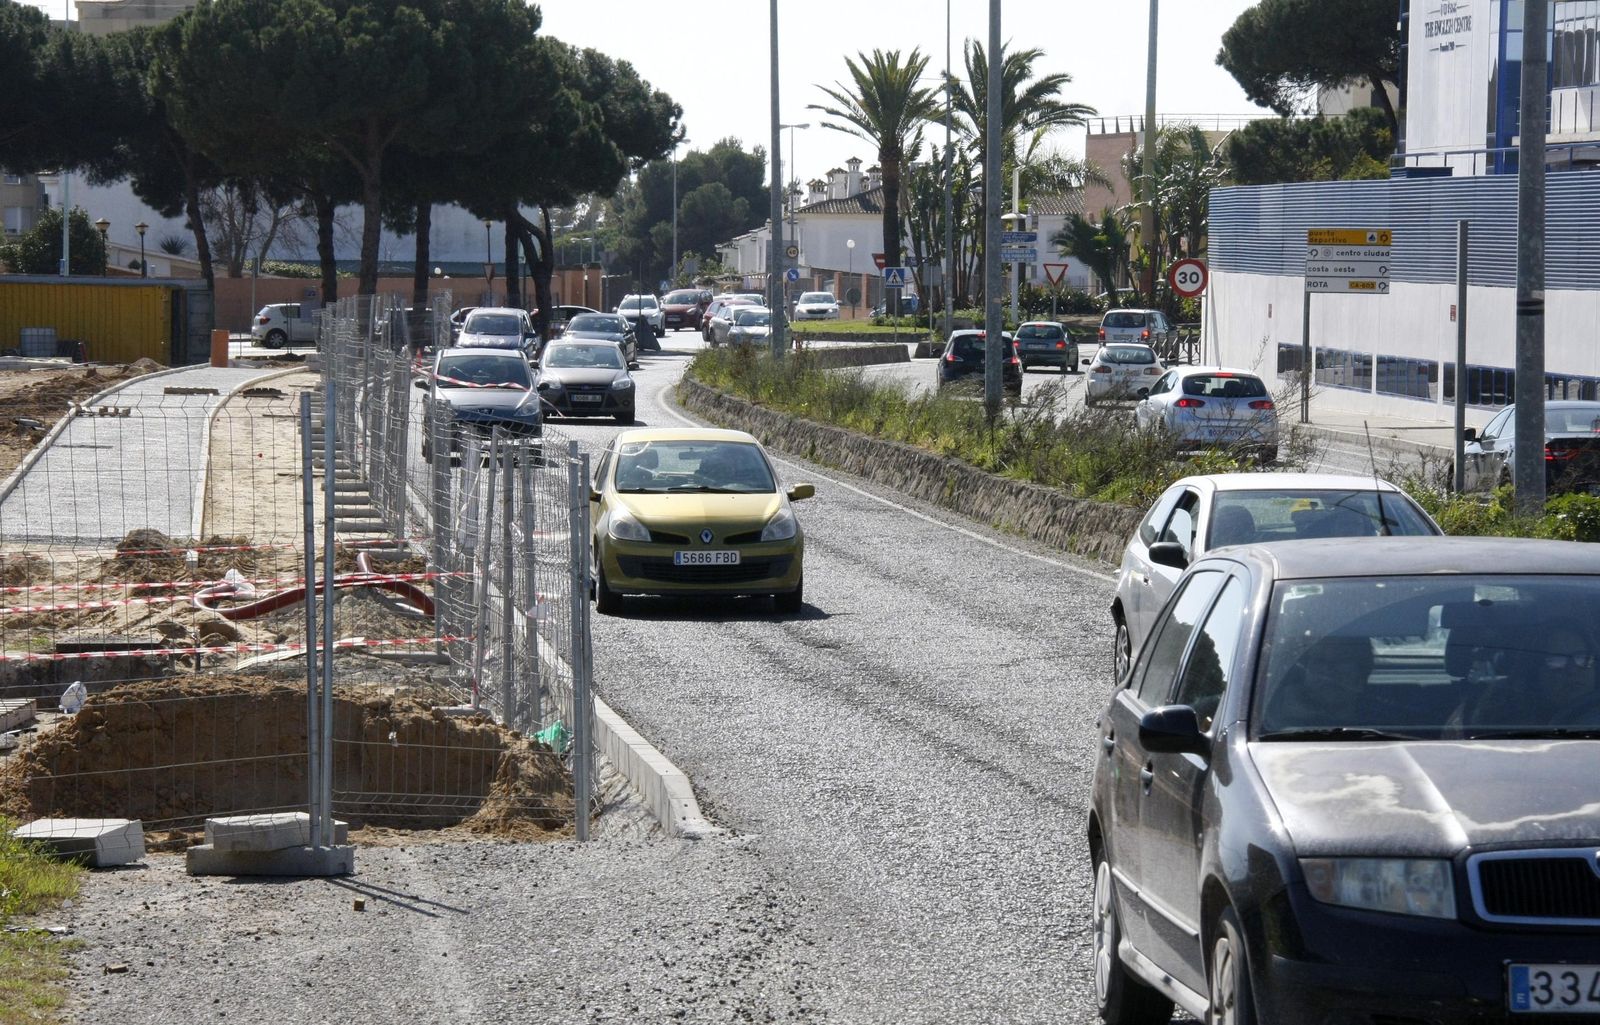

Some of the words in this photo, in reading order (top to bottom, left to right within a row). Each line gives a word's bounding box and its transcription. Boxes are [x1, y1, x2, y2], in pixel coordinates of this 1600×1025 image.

[1425, 21, 1434, 38] THE
[1454, 15, 1472, 34] CENTRE
[1309, 236, 1347, 244] deportivo
[1336, 249, 1361, 257] centro
[1363, 249, 1390, 257] ciudad
[1308, 265, 1329, 273] costa
[1333, 265, 1356, 273] oeste
[1178, 271, 1200, 284] 30
[683, 552, 712, 564] 5686
[715, 552, 737, 563] FBD
